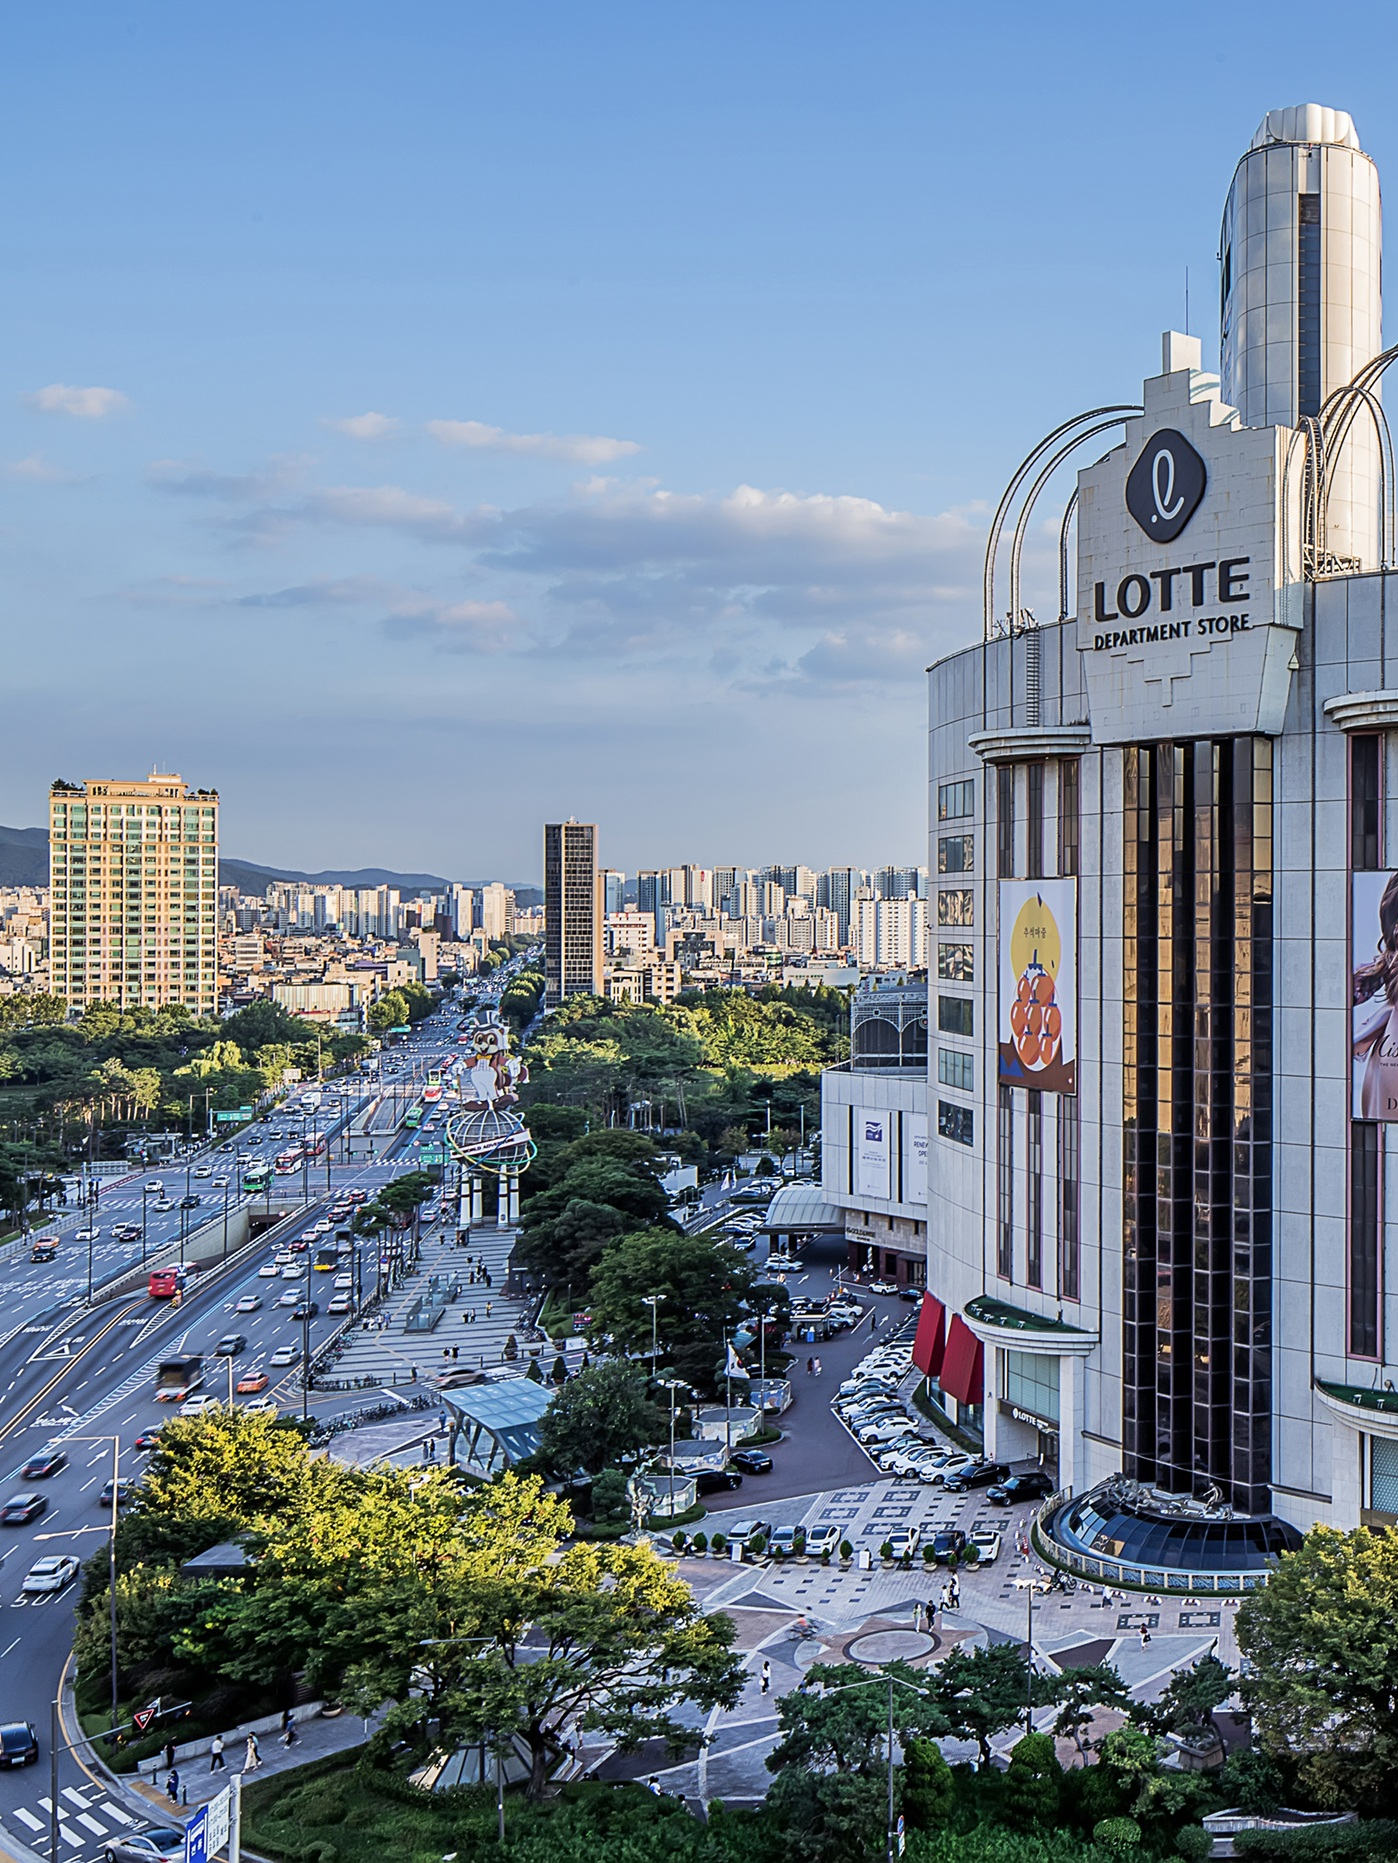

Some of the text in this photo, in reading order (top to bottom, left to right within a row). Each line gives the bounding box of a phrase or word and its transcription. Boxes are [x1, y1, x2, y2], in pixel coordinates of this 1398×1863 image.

[1094, 556, 1250, 622] LOTTE
[1094, 613, 1250, 650] DEPARTMENT STORE
[1018, 1411, 1036, 1425] LOTTE
